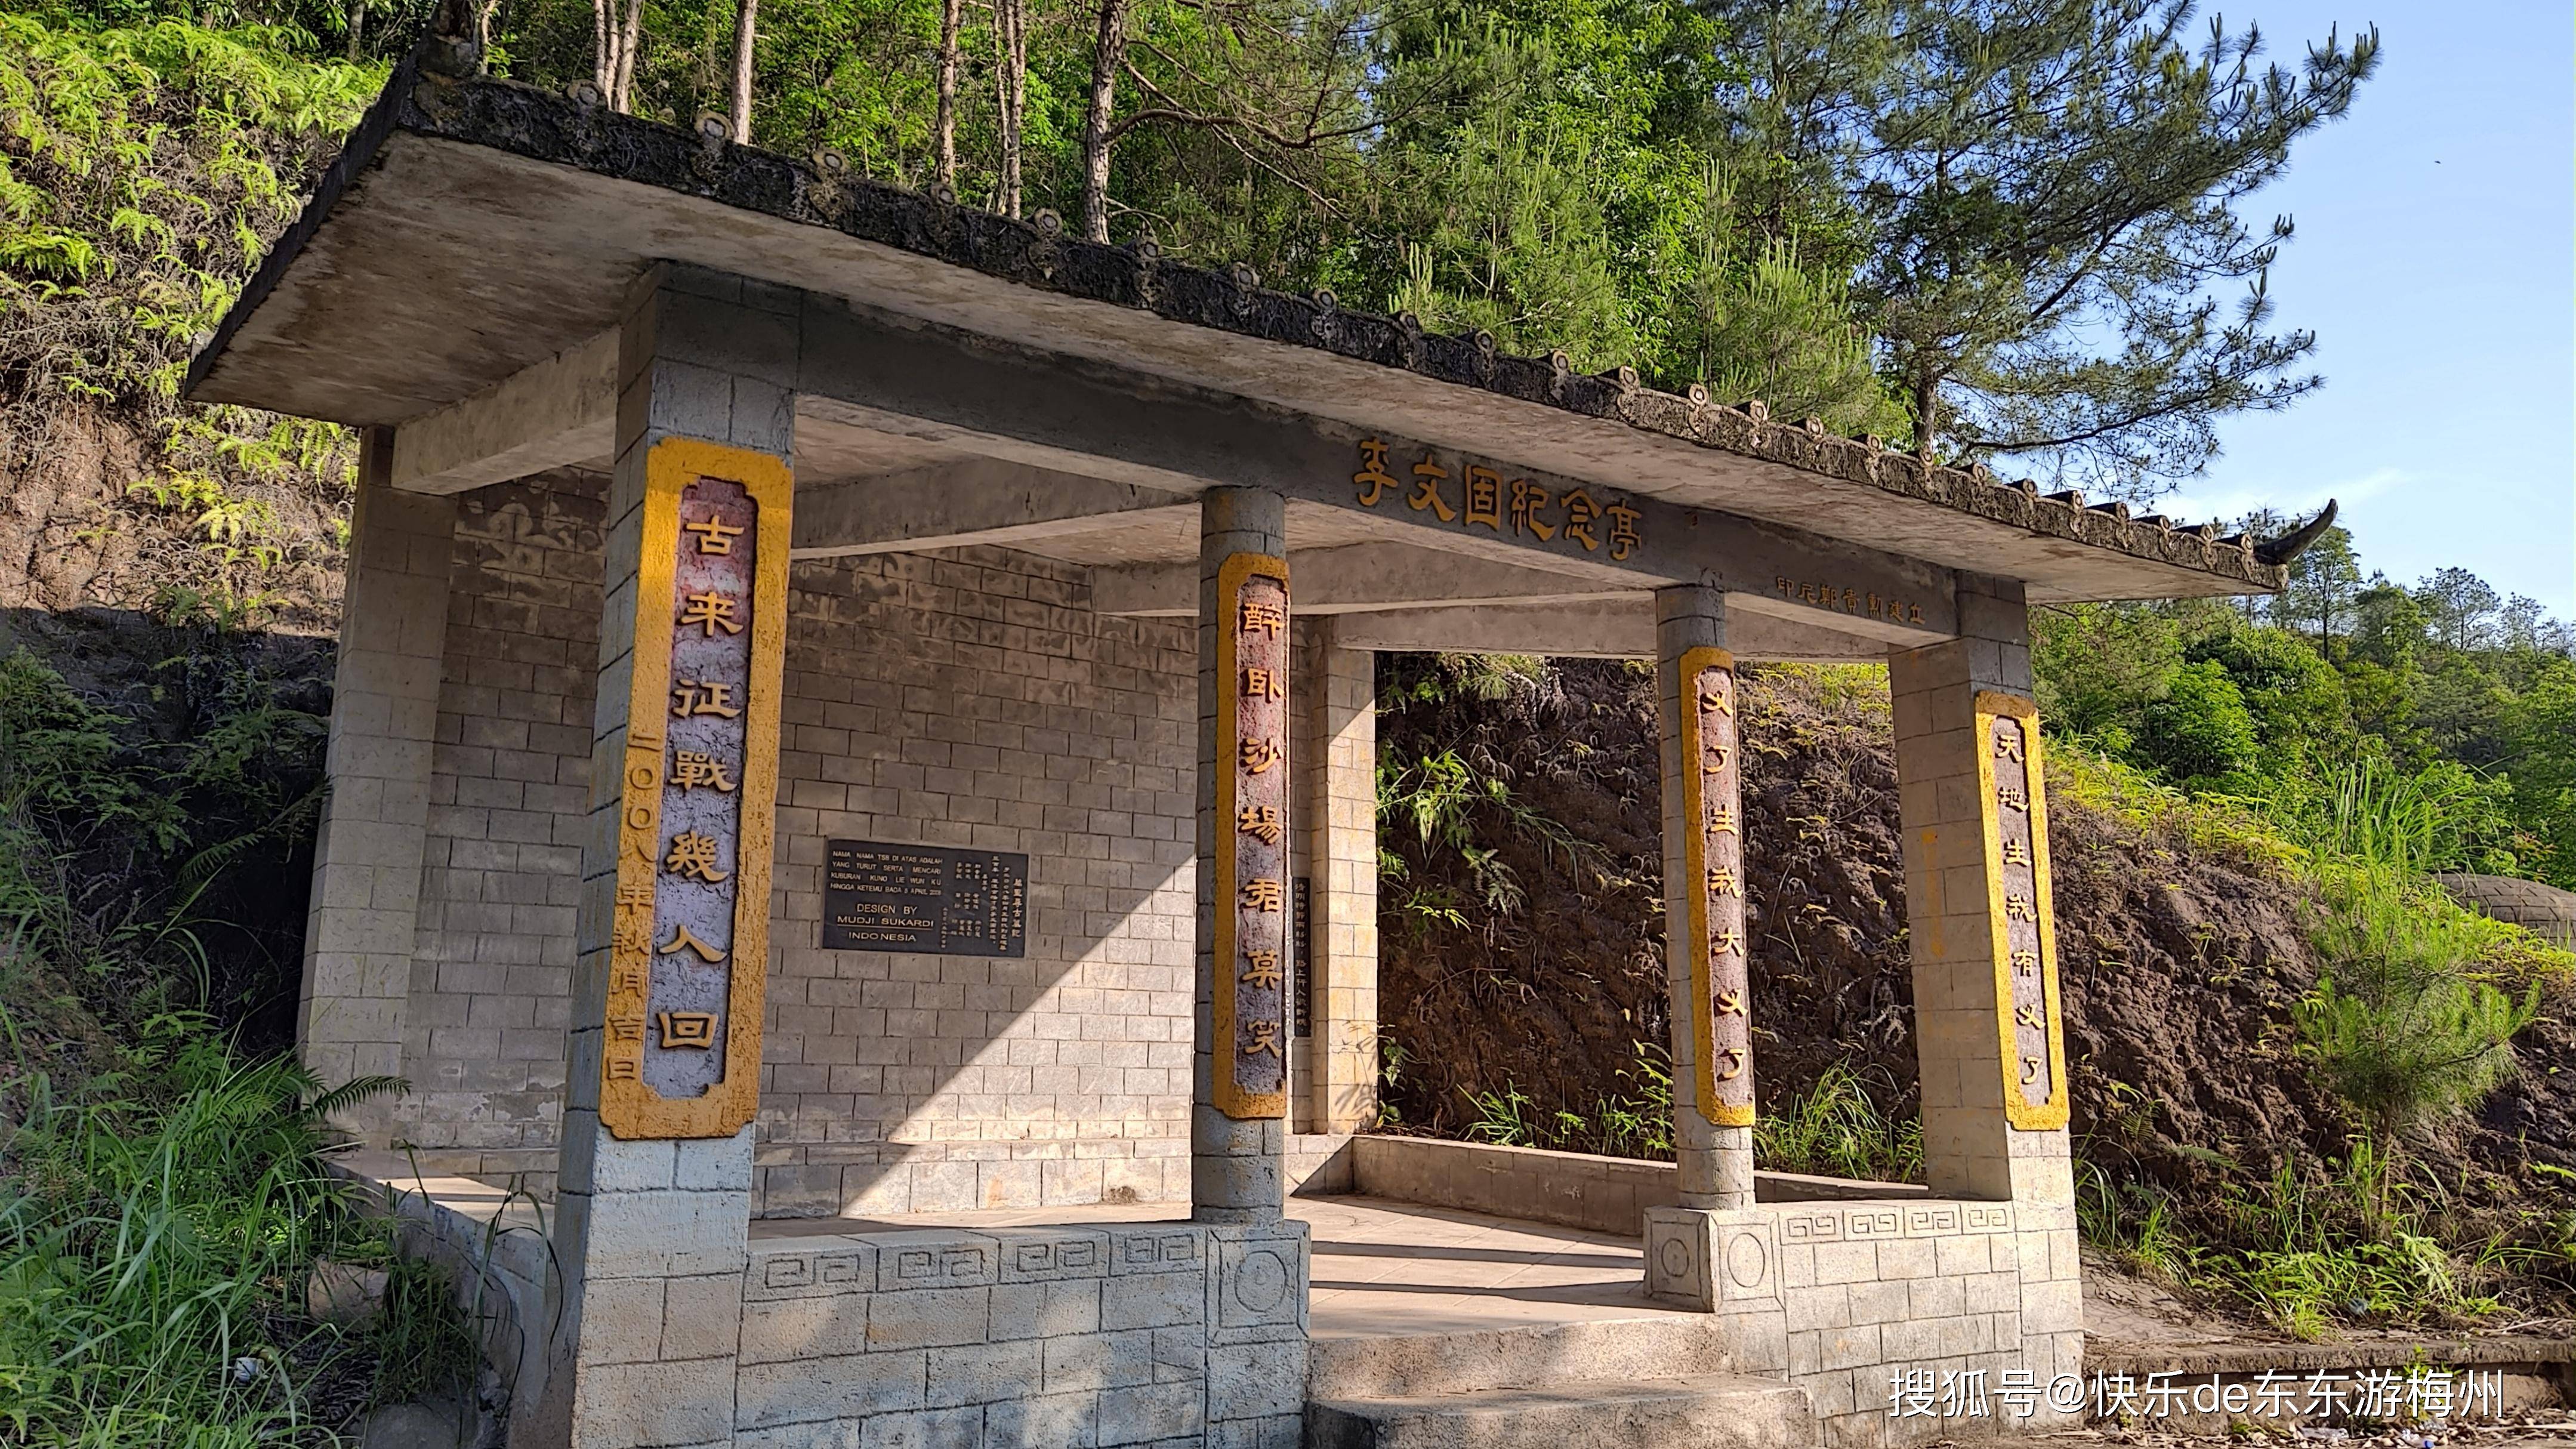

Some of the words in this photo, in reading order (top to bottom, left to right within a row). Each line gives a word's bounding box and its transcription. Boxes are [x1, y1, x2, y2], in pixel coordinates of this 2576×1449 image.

[1354, 437, 1642, 561] 李文固紀念亭
[912, 866, 941, 874] MENCARI
[831, 872, 861, 880] KUBURAN
[856, 904, 896, 914] DESIGN
[903, 906, 918, 915] BY
[837, 915, 875, 924] MUDJI
[881, 918, 934, 927] SUKARDI
[849, 932, 917, 942] INDONESIA
